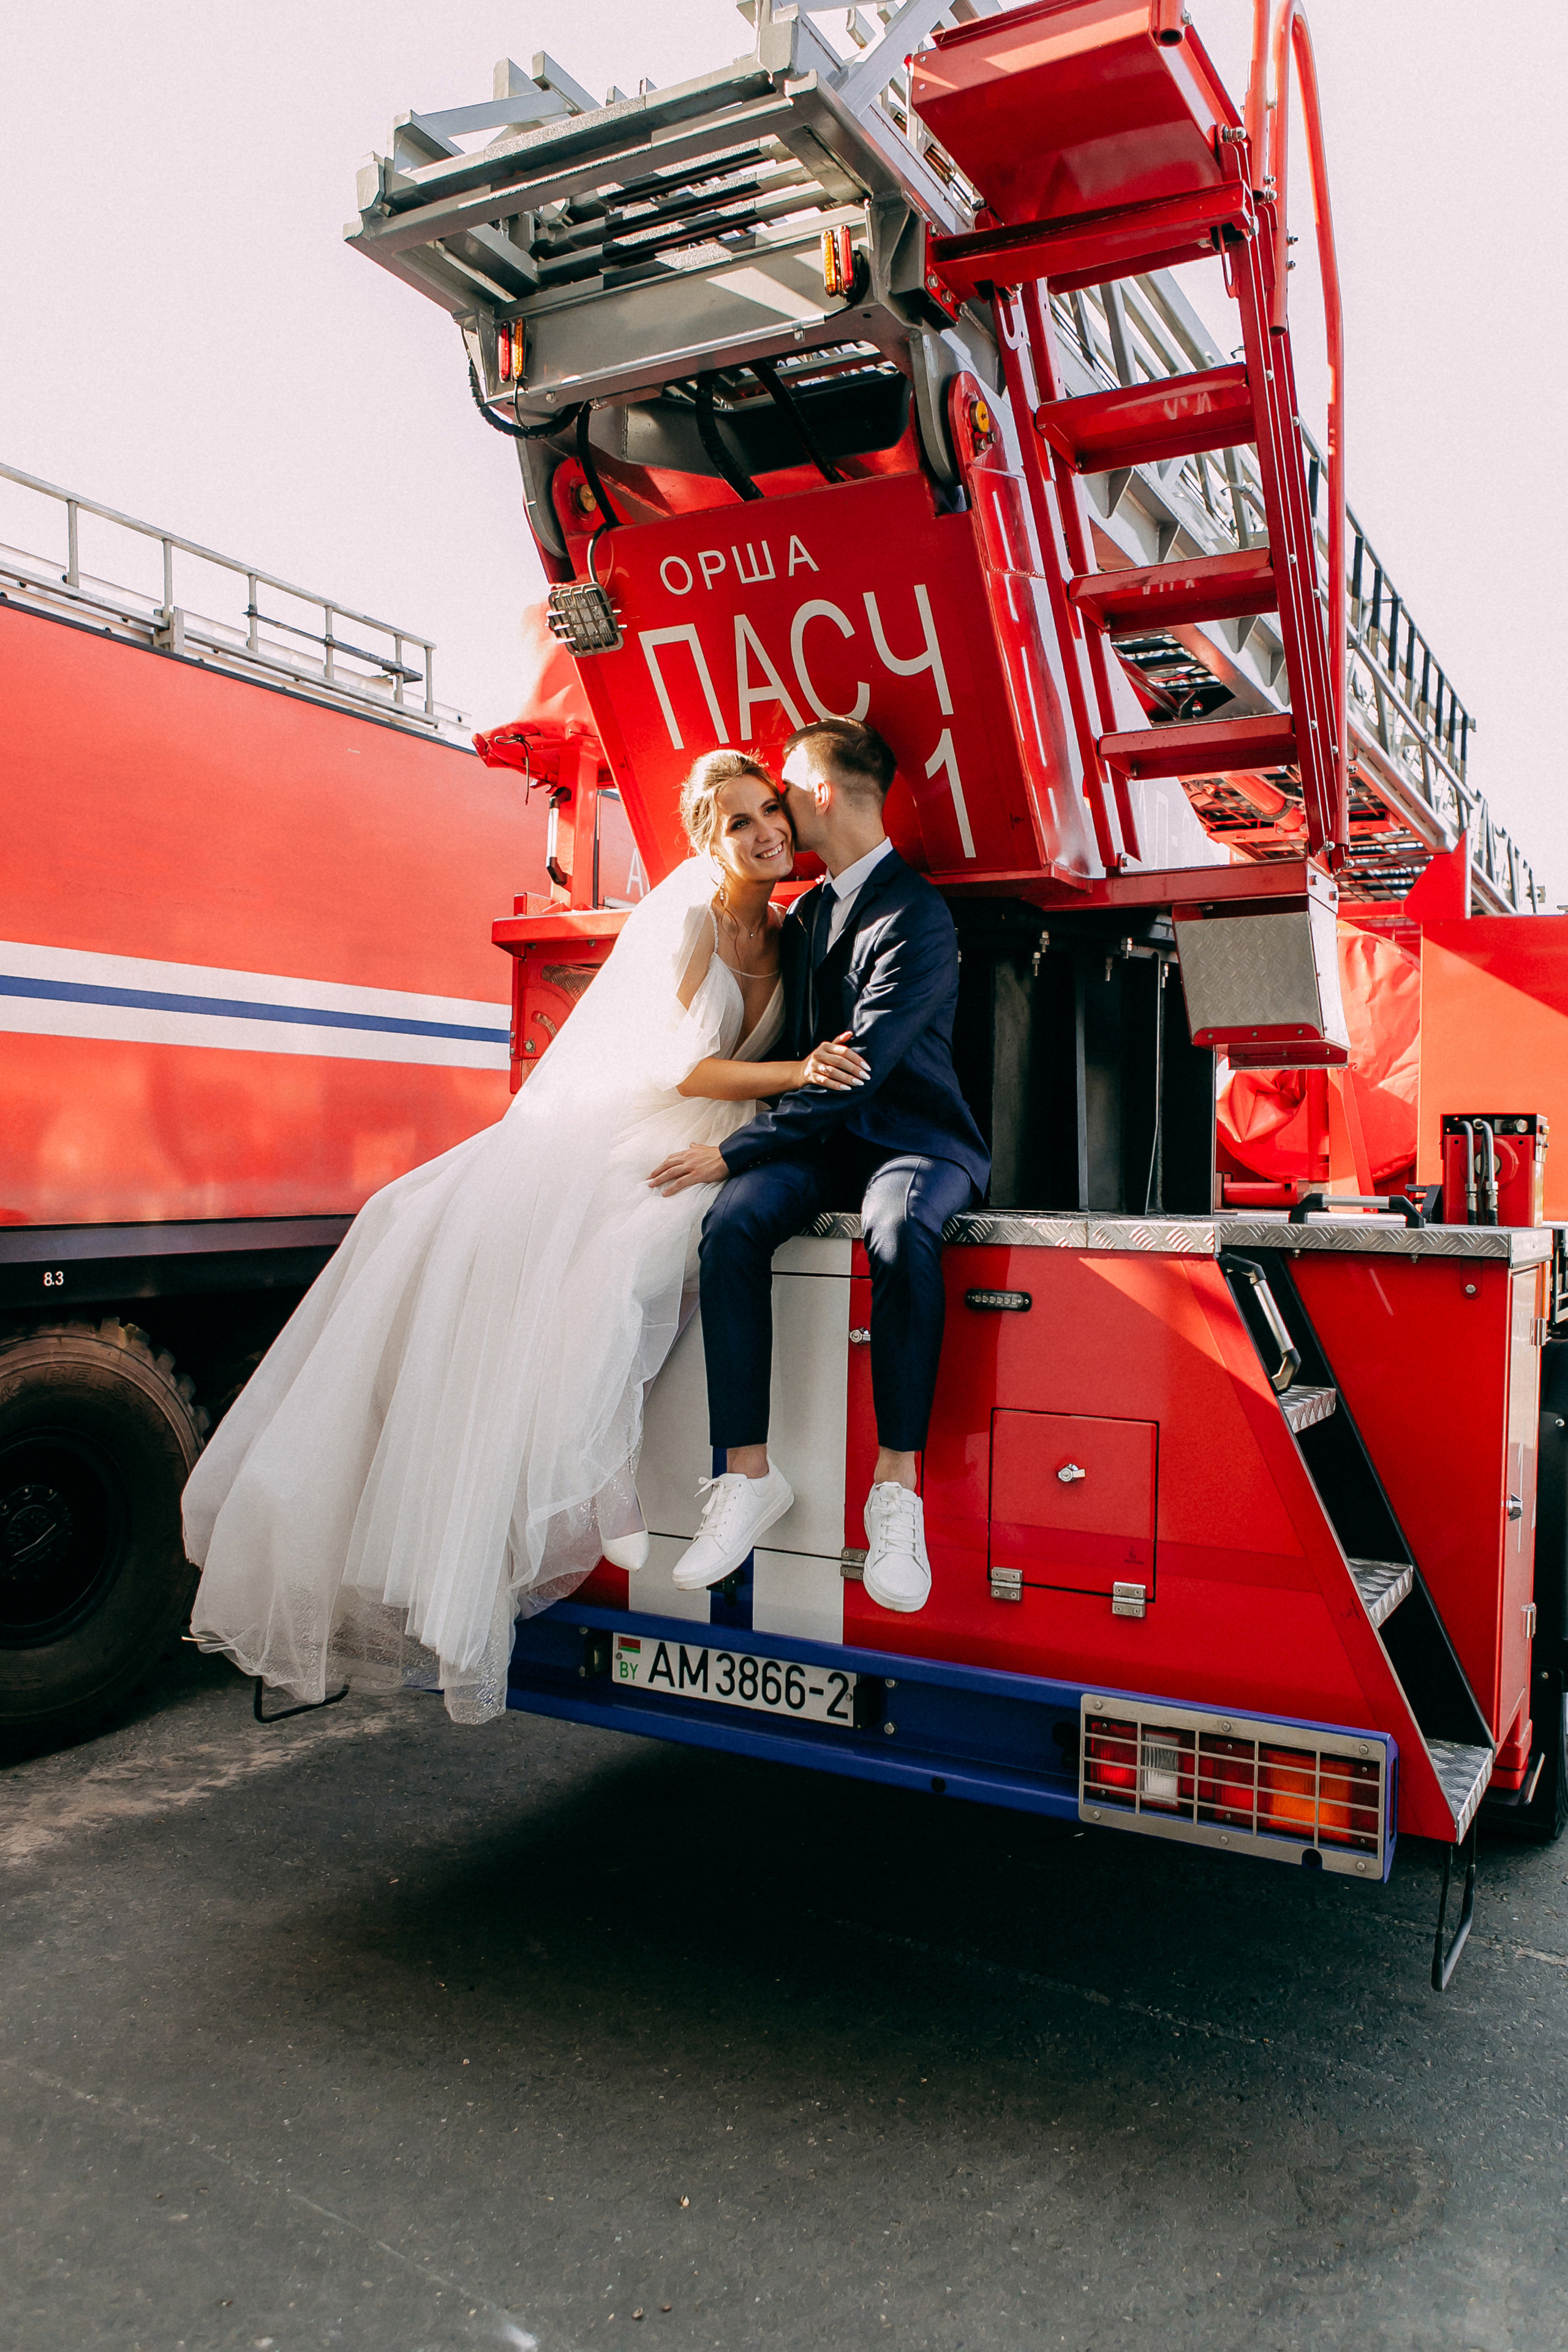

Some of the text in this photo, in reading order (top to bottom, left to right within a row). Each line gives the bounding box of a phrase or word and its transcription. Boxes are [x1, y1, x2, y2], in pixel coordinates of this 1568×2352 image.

[660, 534, 820, 595] ОРША
[638, 583, 954, 750] ПАСЧ
[924, 728, 977, 858] 1
[43, 1271, 64, 1286] 8.3
[619, 1660, 639, 1681] BY
